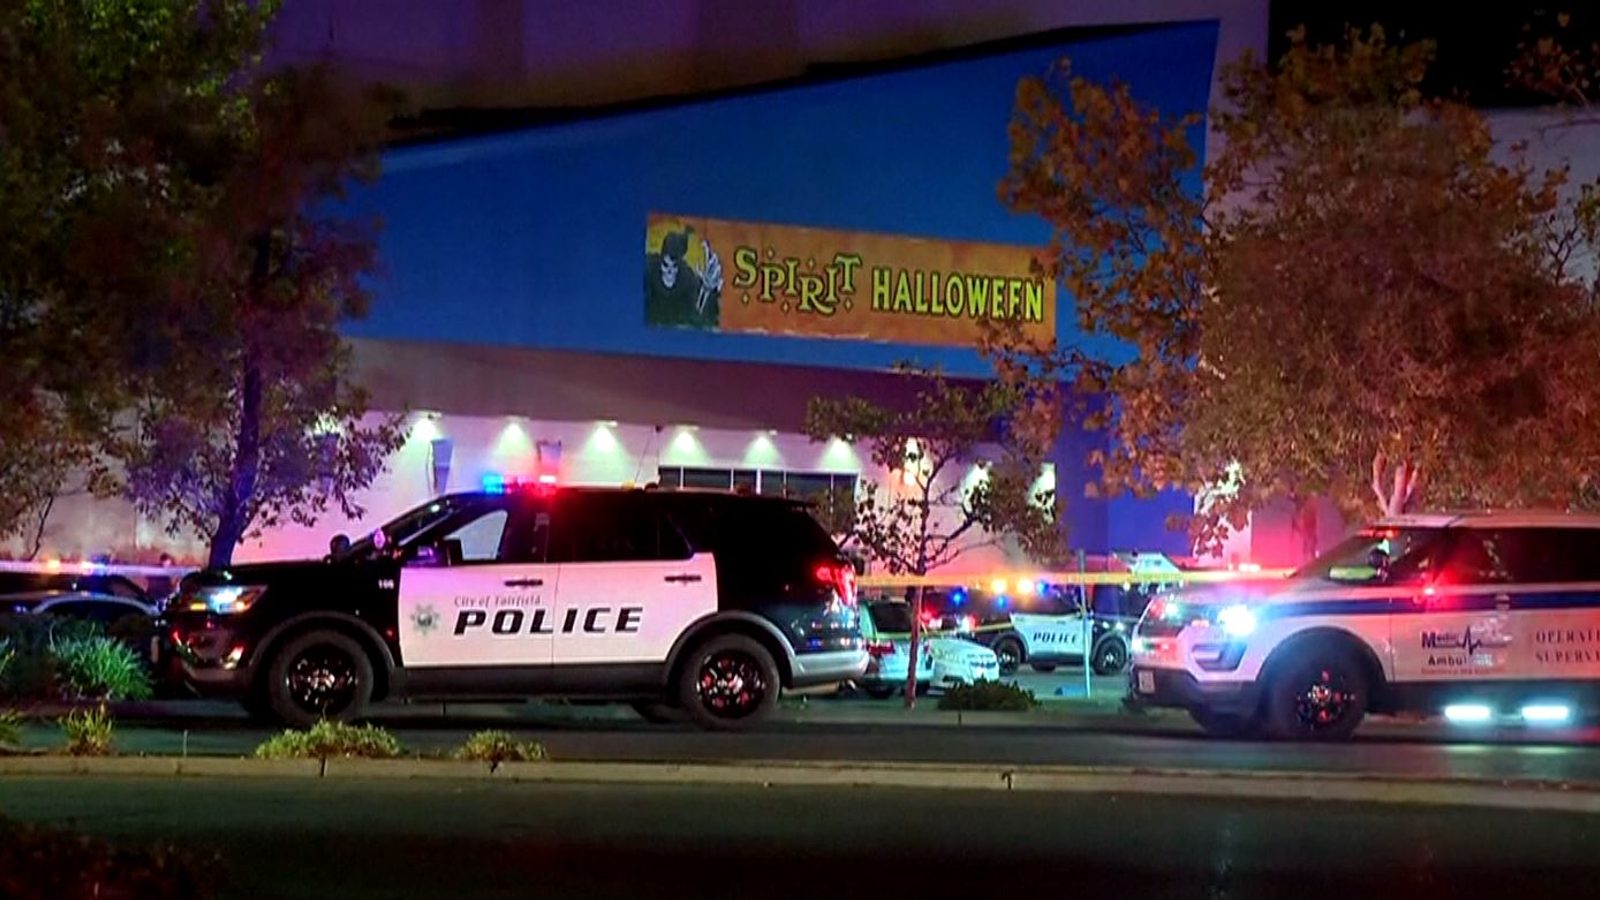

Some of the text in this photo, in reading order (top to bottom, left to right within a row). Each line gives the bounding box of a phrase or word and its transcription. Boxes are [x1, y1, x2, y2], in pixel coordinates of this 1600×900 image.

[734, 247, 1043, 322] SPIRIT HALLOWEEN
[479, 595, 490, 608] of
[454, 606, 643, 636] POLICE
[1033, 631, 1078, 645] POLICE
